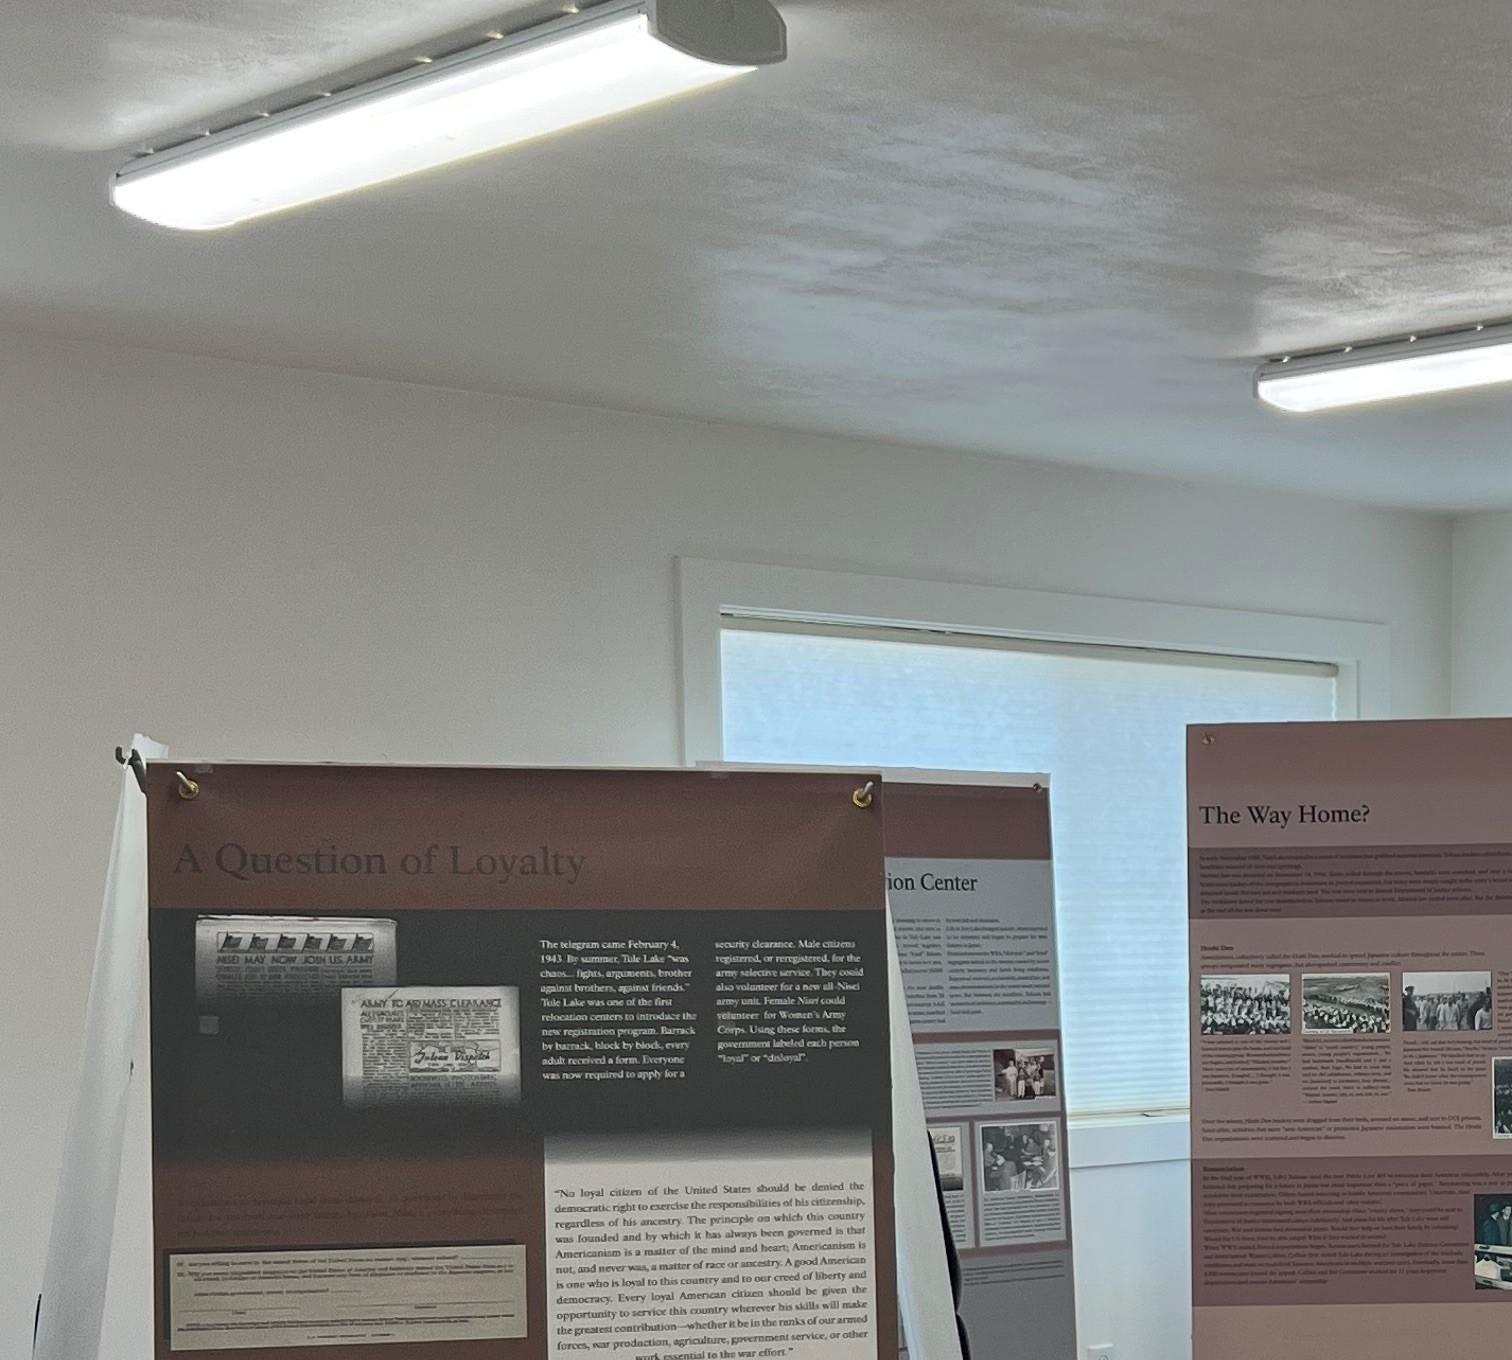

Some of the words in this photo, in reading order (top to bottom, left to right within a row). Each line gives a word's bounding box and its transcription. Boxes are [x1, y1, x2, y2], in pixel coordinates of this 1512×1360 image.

[1199, 805, 1241, 825] The
[1246, 805, 1293, 828] Way
[1298, 804, 1371, 825] Home?
[173, 843, 203, 875] A
[215, 842, 387, 881] Question
[400, 843, 438, 875] of
[448, 845, 587, 886] Loyalty
[920, 873, 978, 891] Center
[539, 939, 559, 949] The
[560, 939, 600, 951] telegram
[628, 939, 669, 951] February
[245, 956, 266, 964] MAY
[272, 956, 297, 964] NOW
[303, 955, 326, 964] JOIN
[348, 955, 373, 964] ARMY
[643, 953, 665, 963] Lake
[715, 982, 734, 991] also
[736, 982, 779, 991] volunteer
[780, 982, 793, 991] for
[423, 999, 446, 1008] MASS
[540, 998, 560, 1007] Tule
[563, 997, 585, 1007] Lake
[637, 997, 652, 1006] the
[654, 997, 673, 1006] first
[541, 1012, 588, 1021] relocation
[589, 1011, 624, 1021] centers
[636, 1011, 681, 1020] introduce
[682, 1011, 697, 1020] the
[763, 1010, 777, 1019] for
[822, 1010, 846, 1021] Army
[563, 1026, 616, 1038] registration
[717, 1038, 771, 1050] government
[806, 1038, 827, 1047] each
[828, 1040, 860, 1049] person
[580, 1187, 604, 1200] loyal
[609, 1186, 642, 1196] citizen
[663, 1185, 679, 1195] the
[685, 1184, 718, 1194] United
[723, 1183, 752, 1194] States
[756, 1183, 790, 1193] should
[811, 1181, 844, 1192] denied
[849, 1181, 865, 1191] the
[554, 1202, 611, 1213] democratic
[612, 1202, 636, 1214] right
[650, 1200, 689, 1211] exercise
[690, 1200, 707, 1210] the
[708, 1198, 781, 1212] responsibilities
[794, 1197, 809, 1207] his
[555, 1217, 605, 1231] regardless
[622, 1216, 637, 1226] his
[687, 1214, 707, 1225] The
[710, 1213, 753, 1226] principle
[773, 1212, 803, 1222] which
[806, 1211, 824, 1221] this
[827, 1210, 865, 1223] country
[577, 1232, 619, 1242] founded
[622, 1231, 641, 1241] and
[660, 1230, 691, 1240] which
[705, 1229, 722, 1239] has
[725, 1228, 758, 1241] always
[760, 1227, 784, 1237] been
[787, 1225, 832, 1239] governed
[846, 1224, 866, 1234] that
[555, 1248, 621, 1259] Americanism
[644, 1246, 678, 1256] matter
[692, 1245, 708, 1255] the
[711, 1244, 737, 1254] mind
[739, 1243, 758, 1253] and
[792, 1240, 855, 1251] Americanism
[577, 1263, 597, 1273] and
[598, 1265, 625, 1273] never
[659, 1260, 690, 1271] matter
[794, 1256, 818, 1269] good
[819, 1254, 866, 1265] American
[587, 1278, 610, 1288] who
[621, 1277, 645, 1290] loyal
[659, 1276, 678, 1286] this
[680, 1274, 719, 1287] country
[721, 1273, 740, 1284] and
[773, 1271, 800, 1282] creed
[815, 1270, 847, 1283] liberty
[848, 1269, 867, 1279] and
